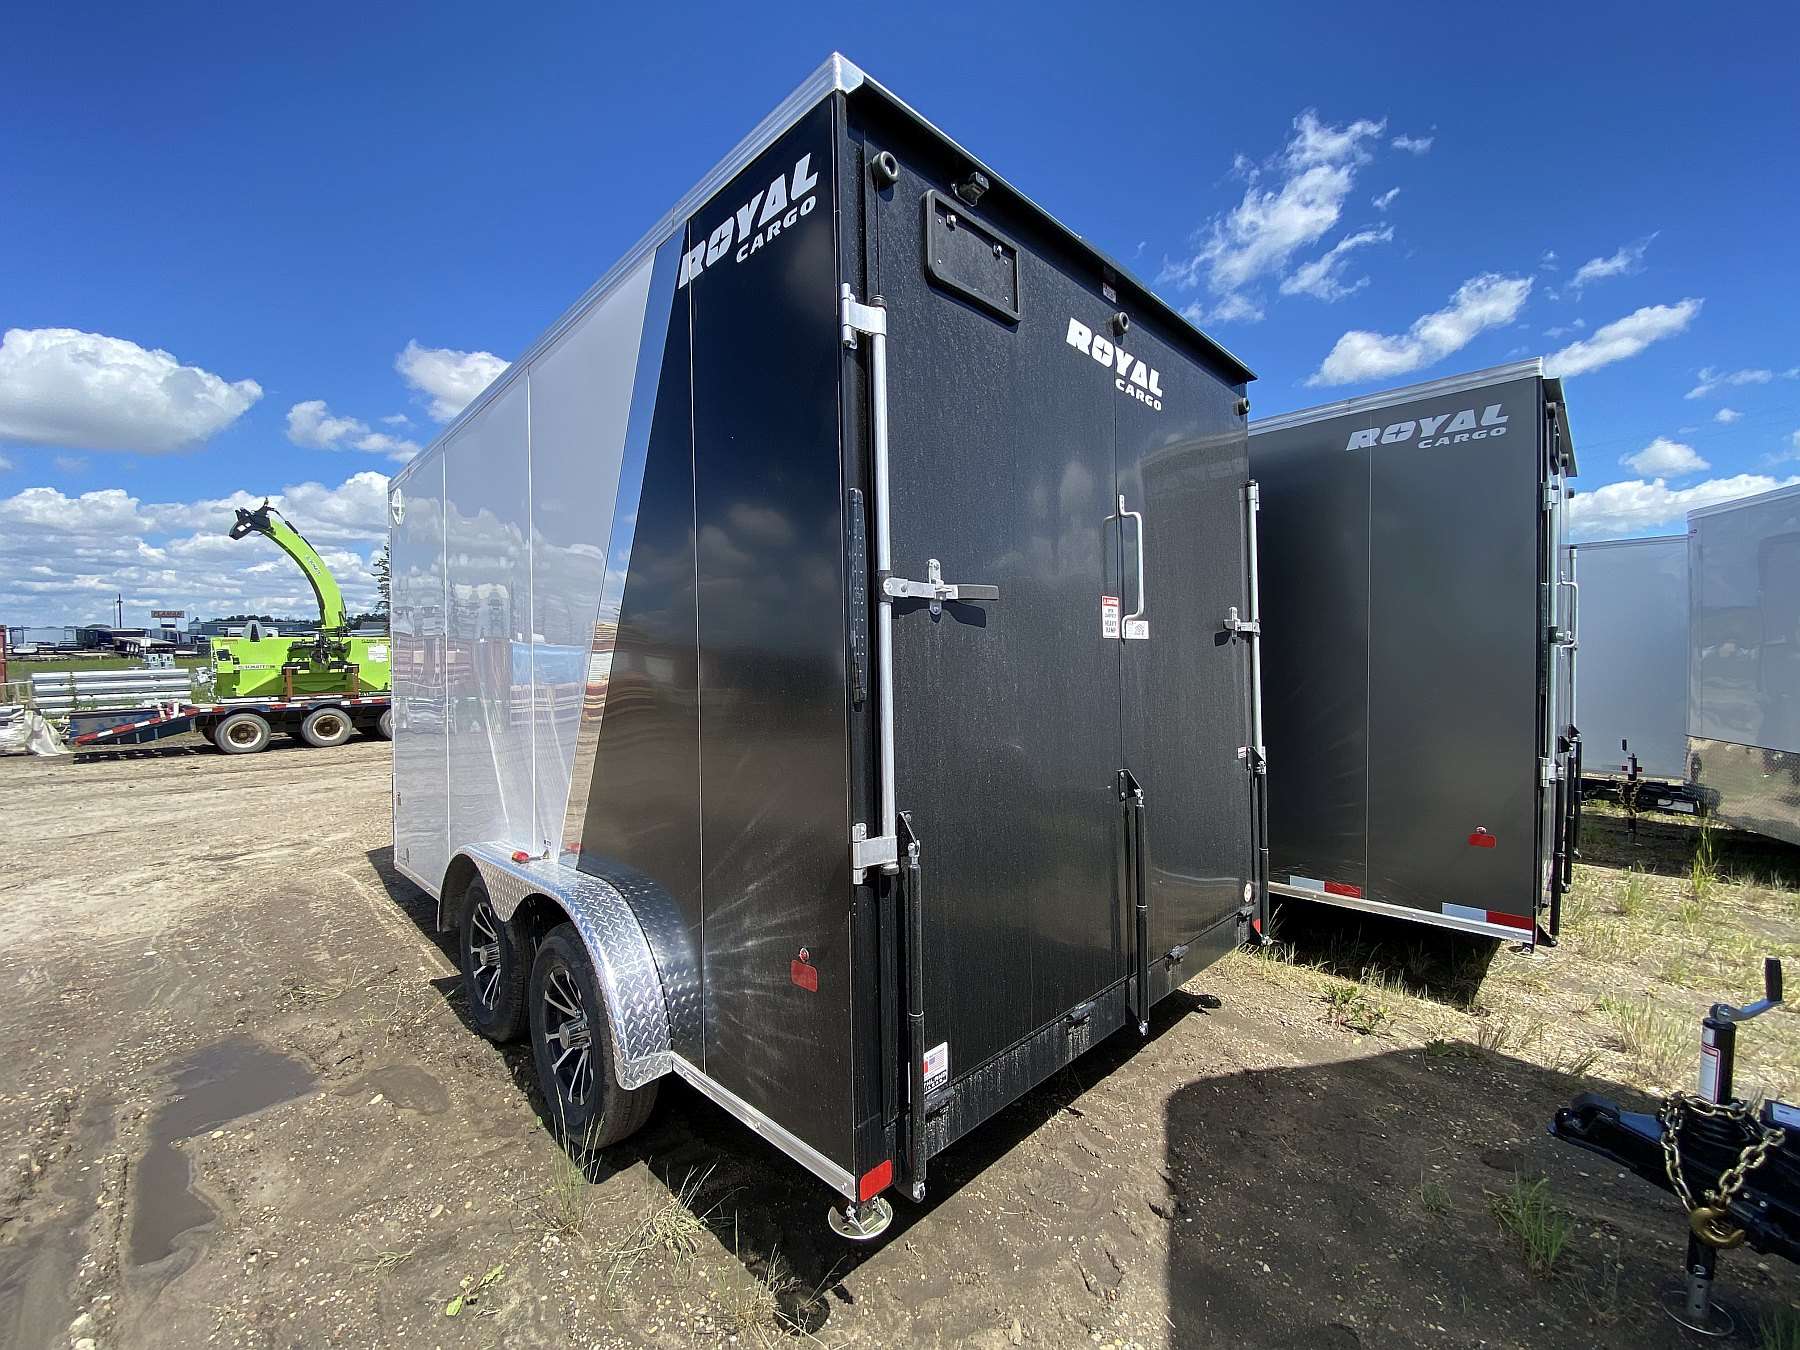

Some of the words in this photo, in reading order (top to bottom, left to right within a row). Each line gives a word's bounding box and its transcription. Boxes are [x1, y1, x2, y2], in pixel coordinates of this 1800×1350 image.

[678, 152, 819, 290] ROYAL
[736, 195, 817, 264] CARGO
[1065, 317, 1163, 398] ROYAL
[1115, 378, 1162, 412] CARGO
[1345, 403, 1509, 451] ROYAL
[1417, 426, 1507, 449] CARGO
